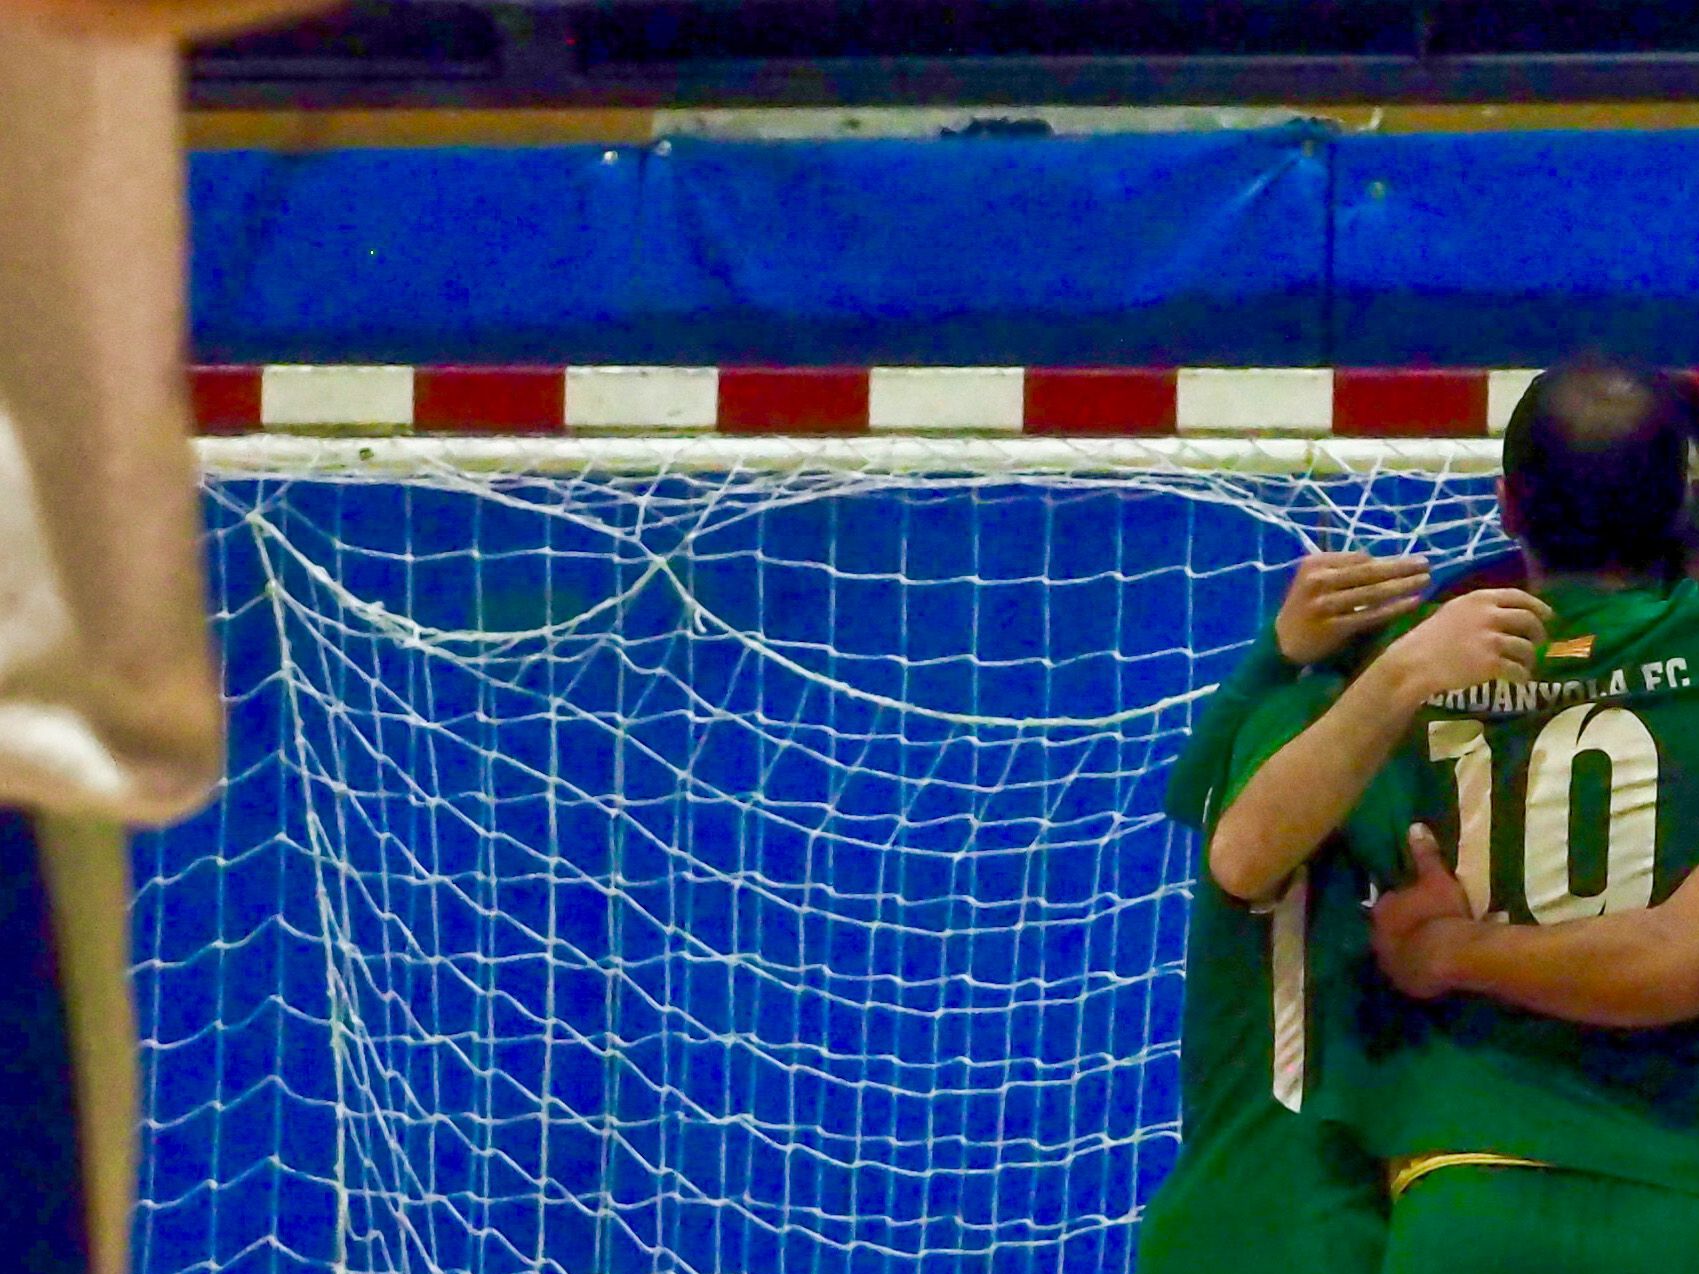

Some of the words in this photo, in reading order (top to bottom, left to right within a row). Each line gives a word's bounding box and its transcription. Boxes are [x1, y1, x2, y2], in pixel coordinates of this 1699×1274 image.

[1420, 668, 1629, 713] RDANYOLA
[1641, 657, 1691, 691] FC
[1427, 702, 1659, 926] 10
